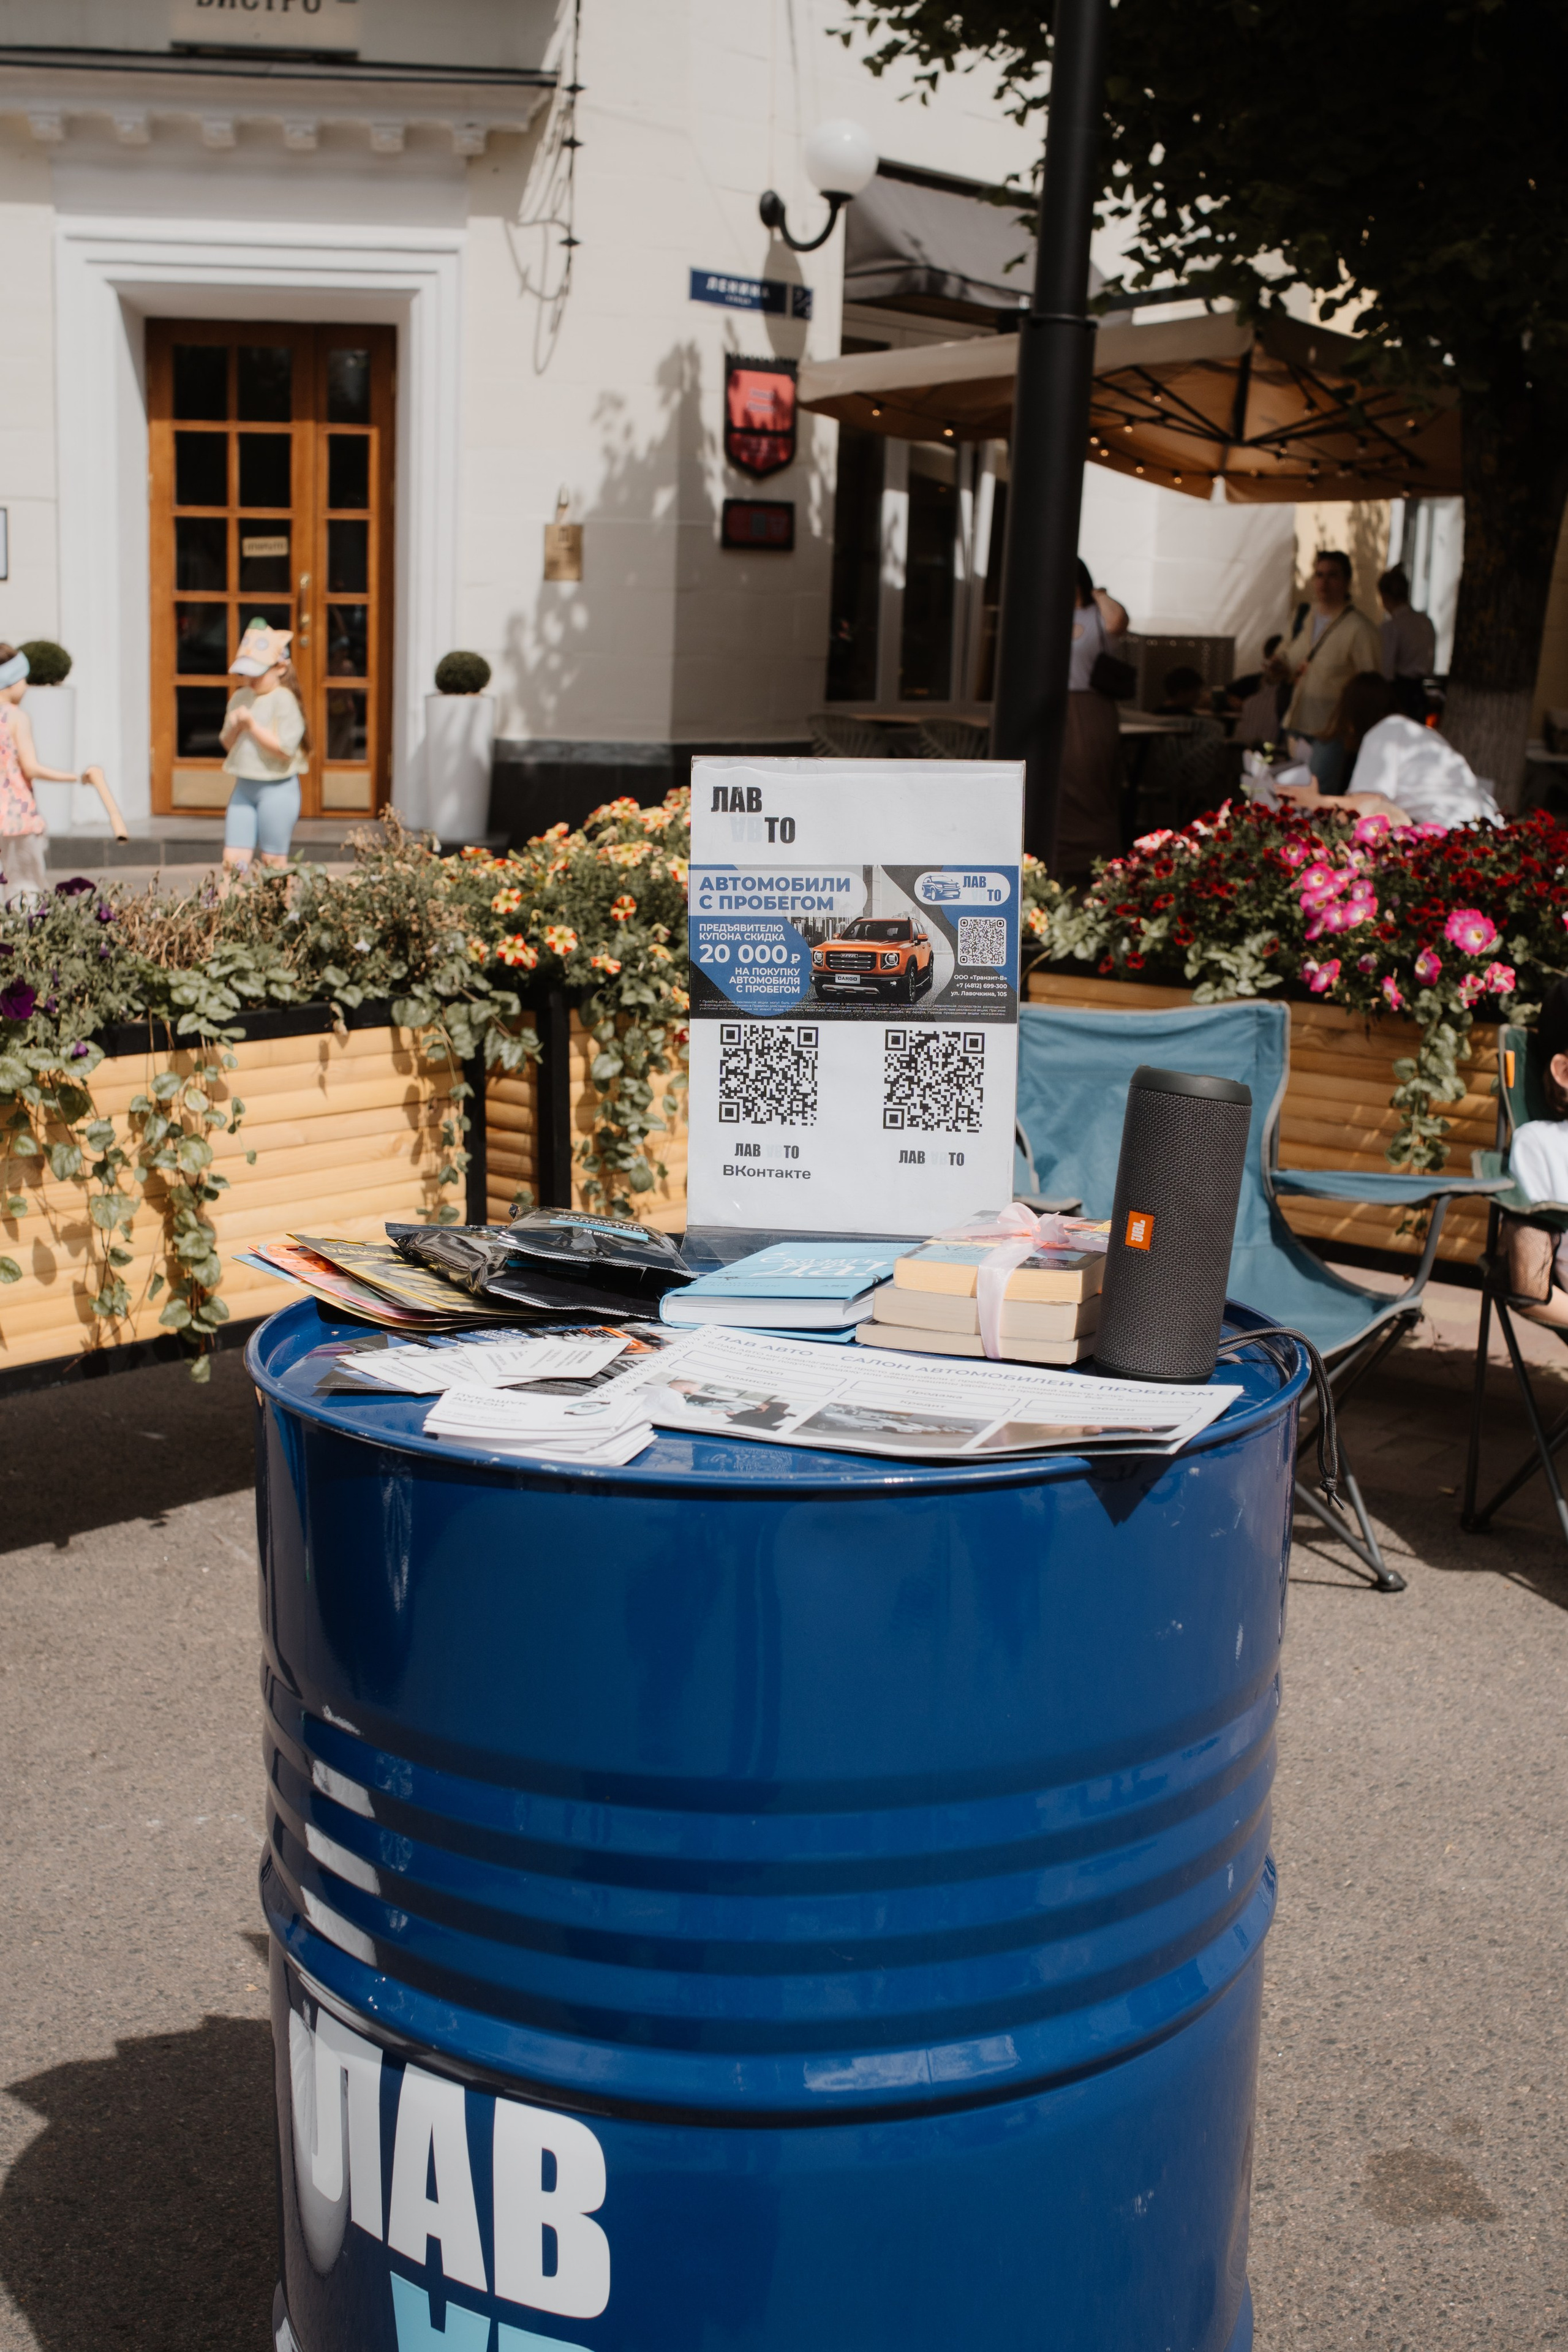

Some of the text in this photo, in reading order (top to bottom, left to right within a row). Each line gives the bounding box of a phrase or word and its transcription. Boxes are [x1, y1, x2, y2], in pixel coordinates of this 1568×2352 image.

[710, 786, 762, 813] ЛАВ
[699, 876, 850, 892] АВТОМОБИЛИ
[962, 875, 986, 888] ЛАВ
[699, 895, 834, 911] С ПРОБЕГОМ
[699, 924, 783, 933] ПРЕДЪЯВИТЕЛЮ
[744, 933, 785, 942] СКИДКА
[699, 944, 731, 963] 20
[729, 976, 800, 985] АВТОМОБИЛЯ
[745, 985, 800, 993] ПРОБЕГОМ
[734, 1143, 761, 1157] ЛАВ
[899, 1150, 925, 1164] ЛАВ
[723, 1164, 811, 1180] ВКонтакте
[1131, 1219, 1145, 1242] JBL
[320, 1246, 405, 1261] DANGER
[715, 1335, 758, 1347] ЛАВ
[761, 1345, 813, 1355] АВТО
[841, 1356, 911, 1370] САЛОН
[915, 1367, 1074, 1387] АВТОМОБИЛЕЙ
[1099, 1385, 1215, 1396] ПРОБЕГОМ
[746, 1366, 783, 1376] Выкуп
[906, 1389, 962, 1400] Продажа
[900, 1400, 945, 1408] Кредит
[311, 2007, 610, 2319] ЛАВ
